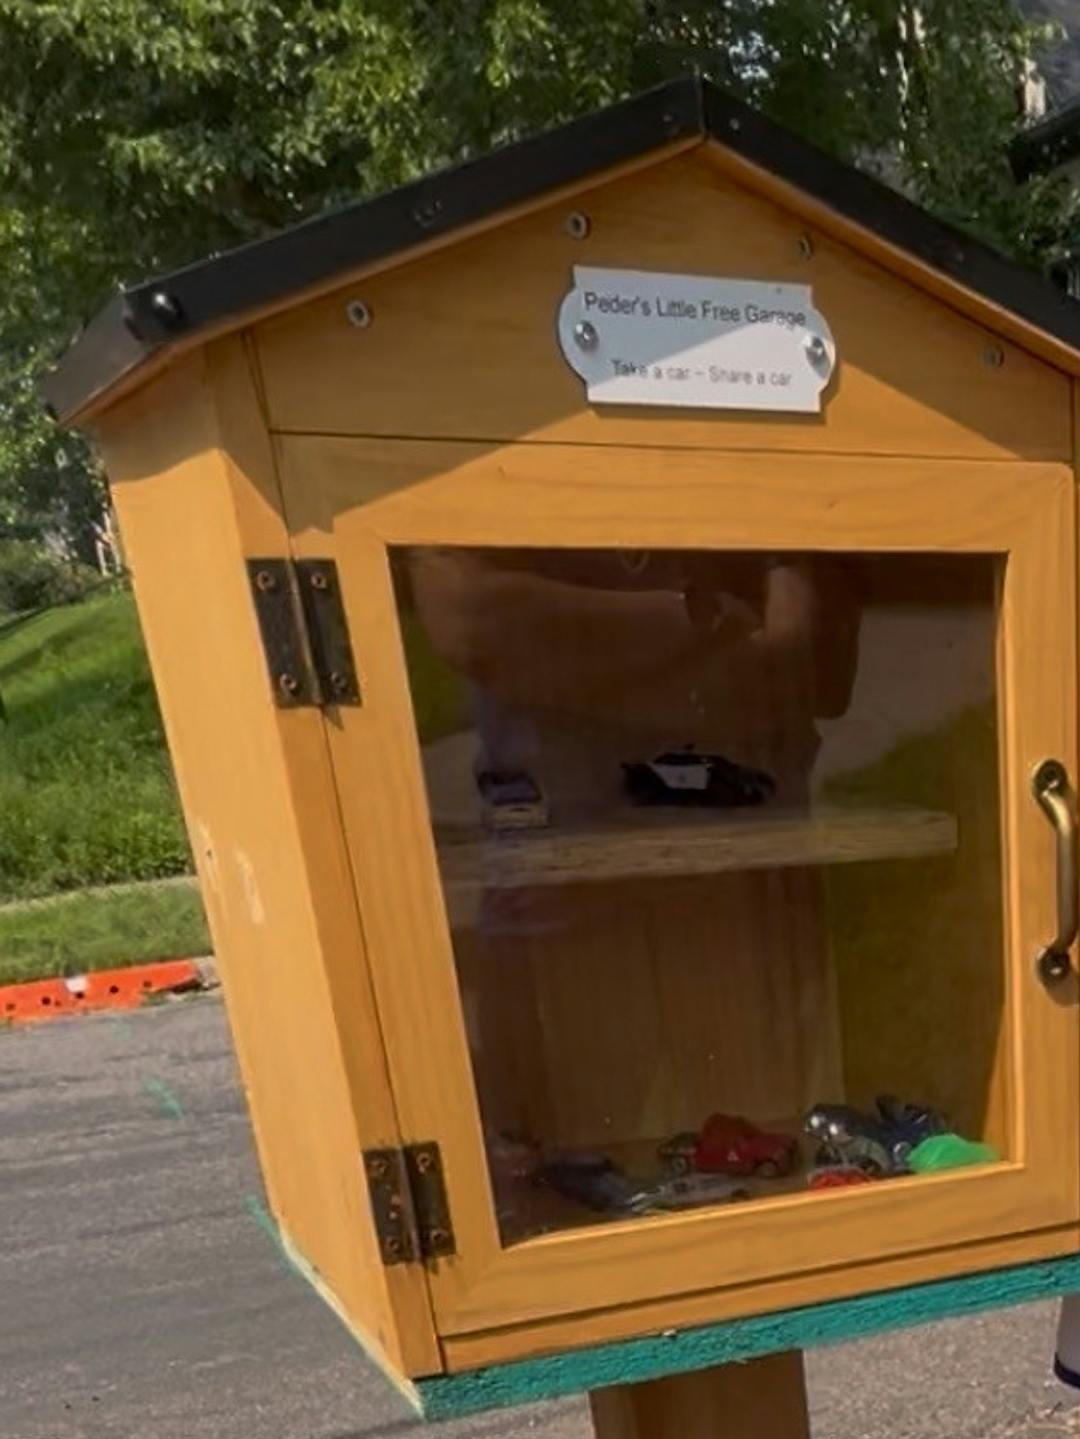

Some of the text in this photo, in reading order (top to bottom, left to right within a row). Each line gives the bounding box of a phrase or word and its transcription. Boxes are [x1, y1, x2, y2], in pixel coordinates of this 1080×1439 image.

[584, 291, 806, 331] Peder's Little Free Garage
[610, 358, 648, 377] Take
[654, 366, 662, 379] a
[666, 367, 690, 380] car
[708, 365, 753, 384] Share
[756, 372, 765, 385] a
[770, 372, 792, 386] car
